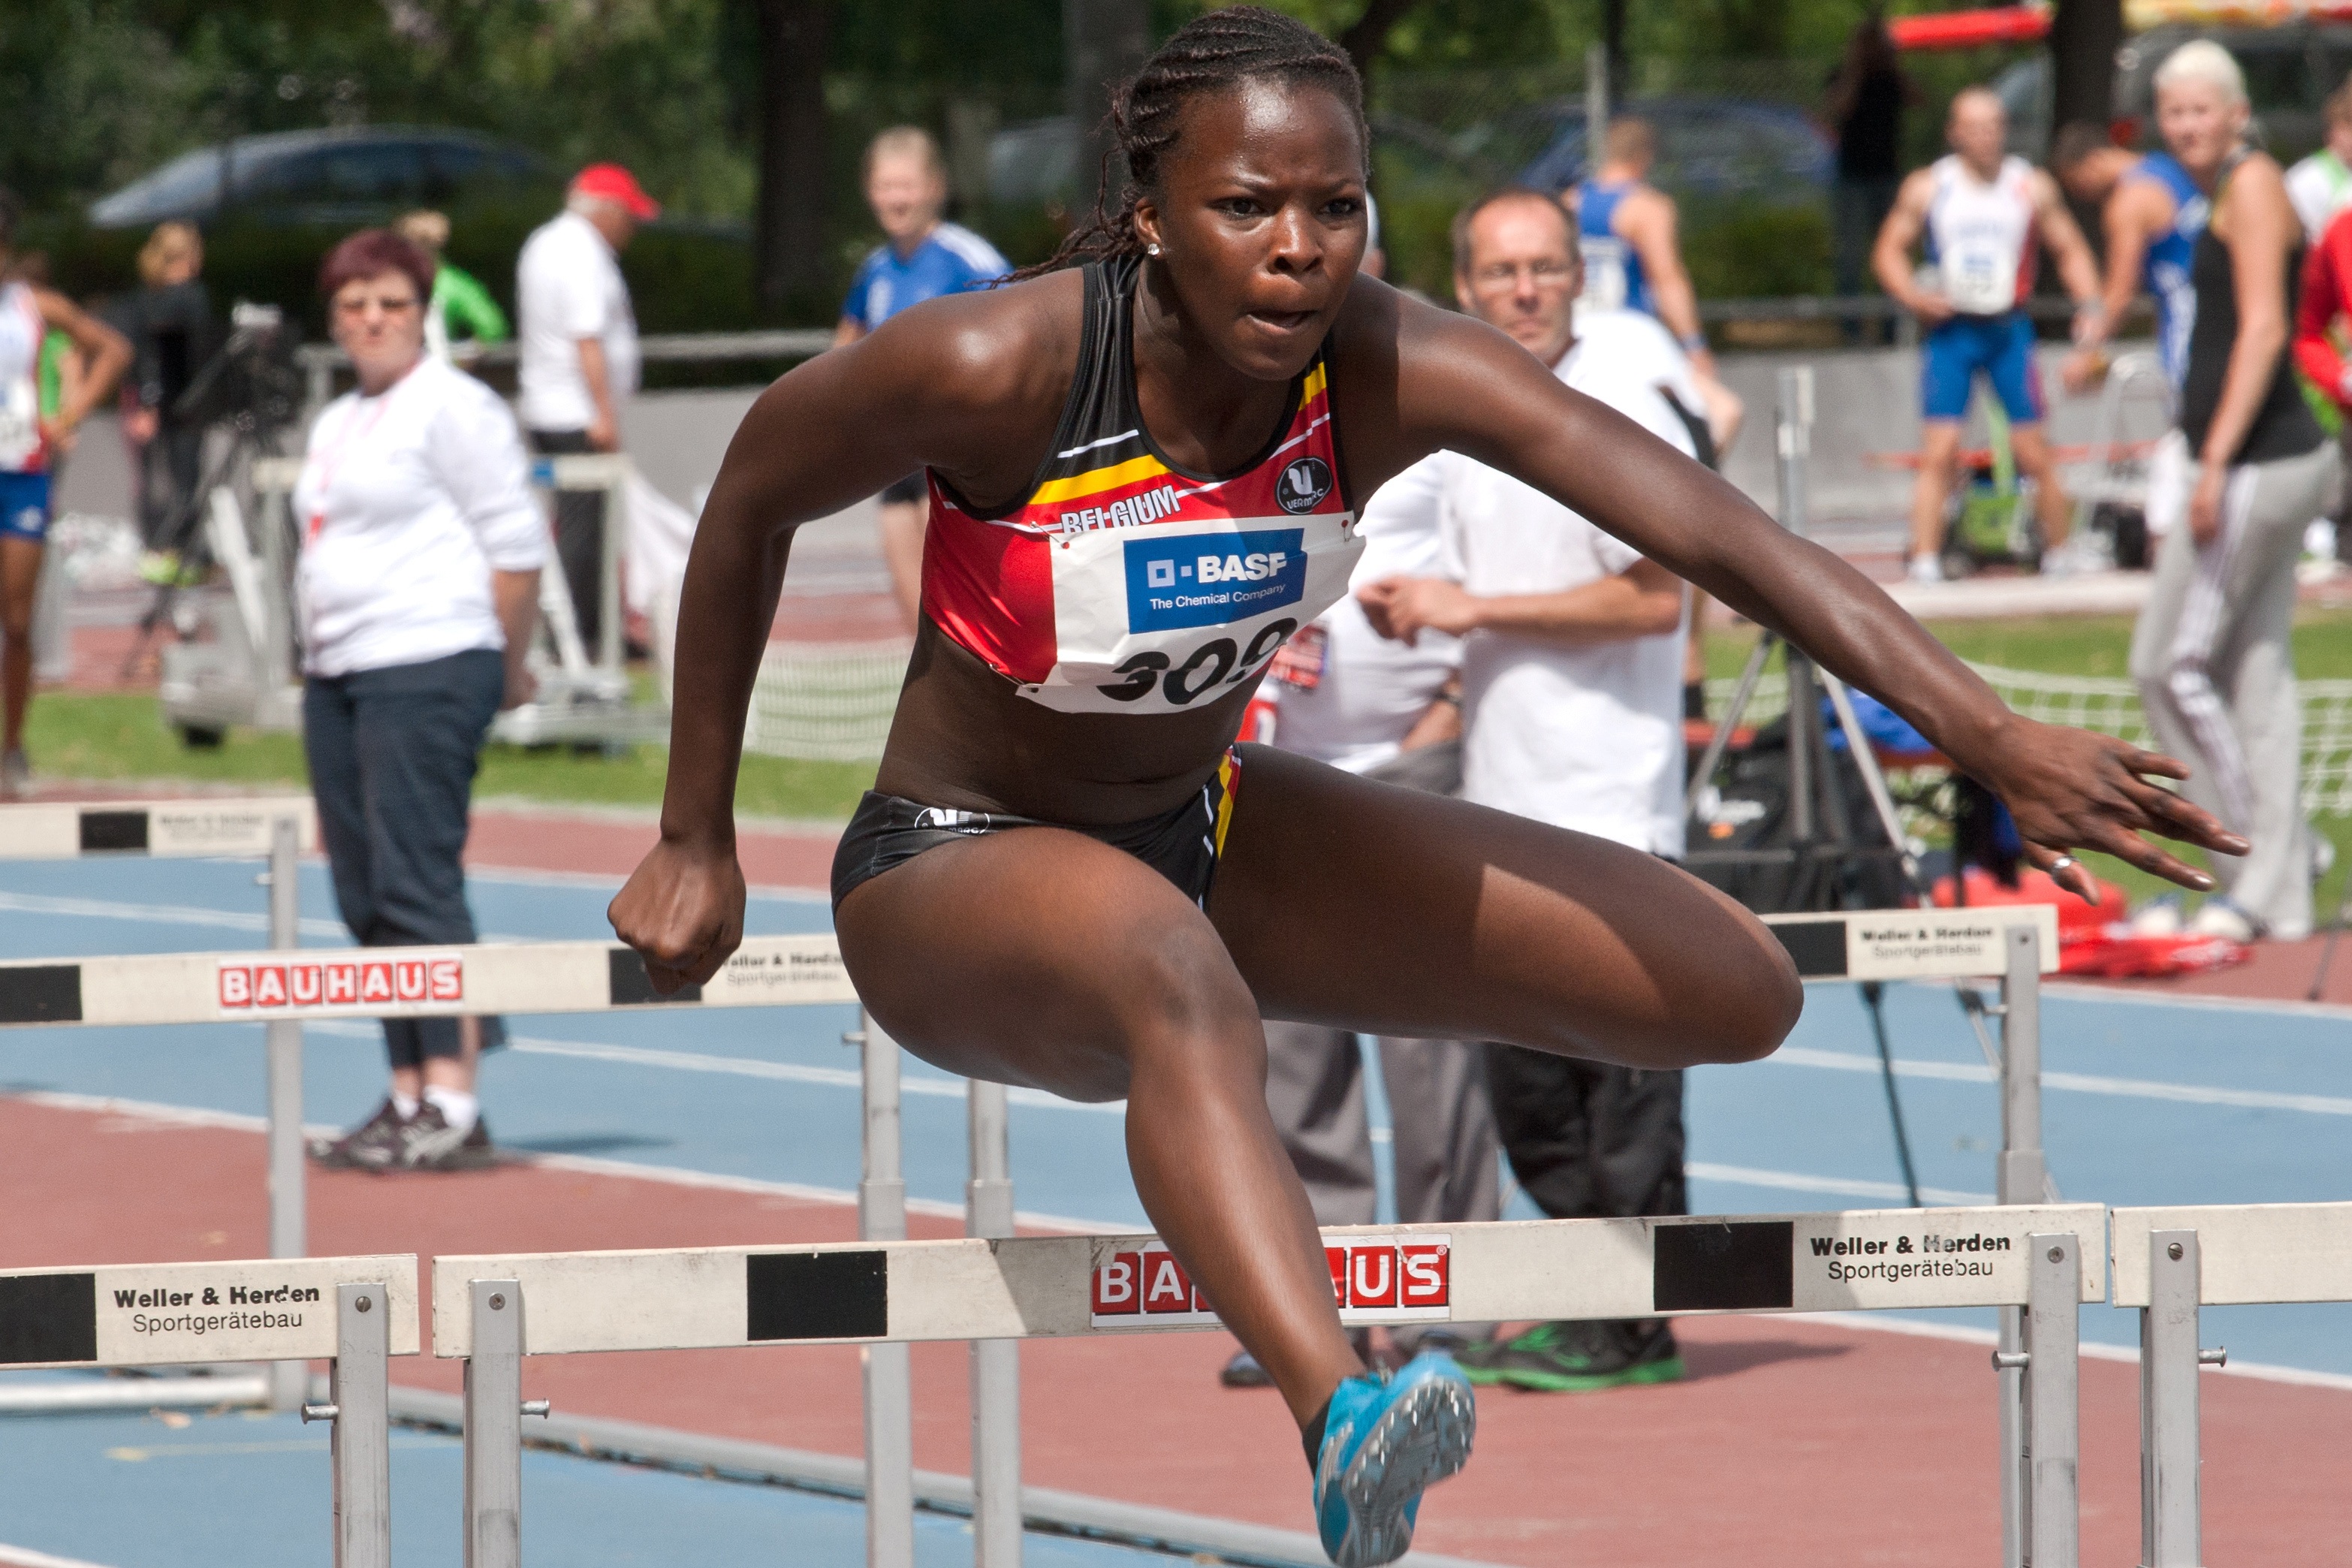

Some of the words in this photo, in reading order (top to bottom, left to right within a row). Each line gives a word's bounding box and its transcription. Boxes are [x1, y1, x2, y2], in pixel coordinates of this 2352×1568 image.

[1060, 484, 1181, 534] BELGIUM
[1198, 552, 1287, 583] BASF
[1150, 598, 1173, 610] The
[1175, 592, 1230, 608] Chemical
[1233, 584, 1286, 602] Company
[223, 963, 460, 1001] BAUHAUS
[1811, 1237, 1888, 1256] Weller
[1896, 1235, 1913, 1254] &
[1923, 1233, 2010, 1253] Herden
[1099, 1253, 1441, 1304] BAUS
[1828, 1259, 1993, 1283] Sportgerätebau
[114, 1289, 193, 1308] Weller
[201, 1286, 220, 1306] &
[229, 1285, 319, 1304] Herden
[133, 1310, 303, 1336] Sportgerätebau
